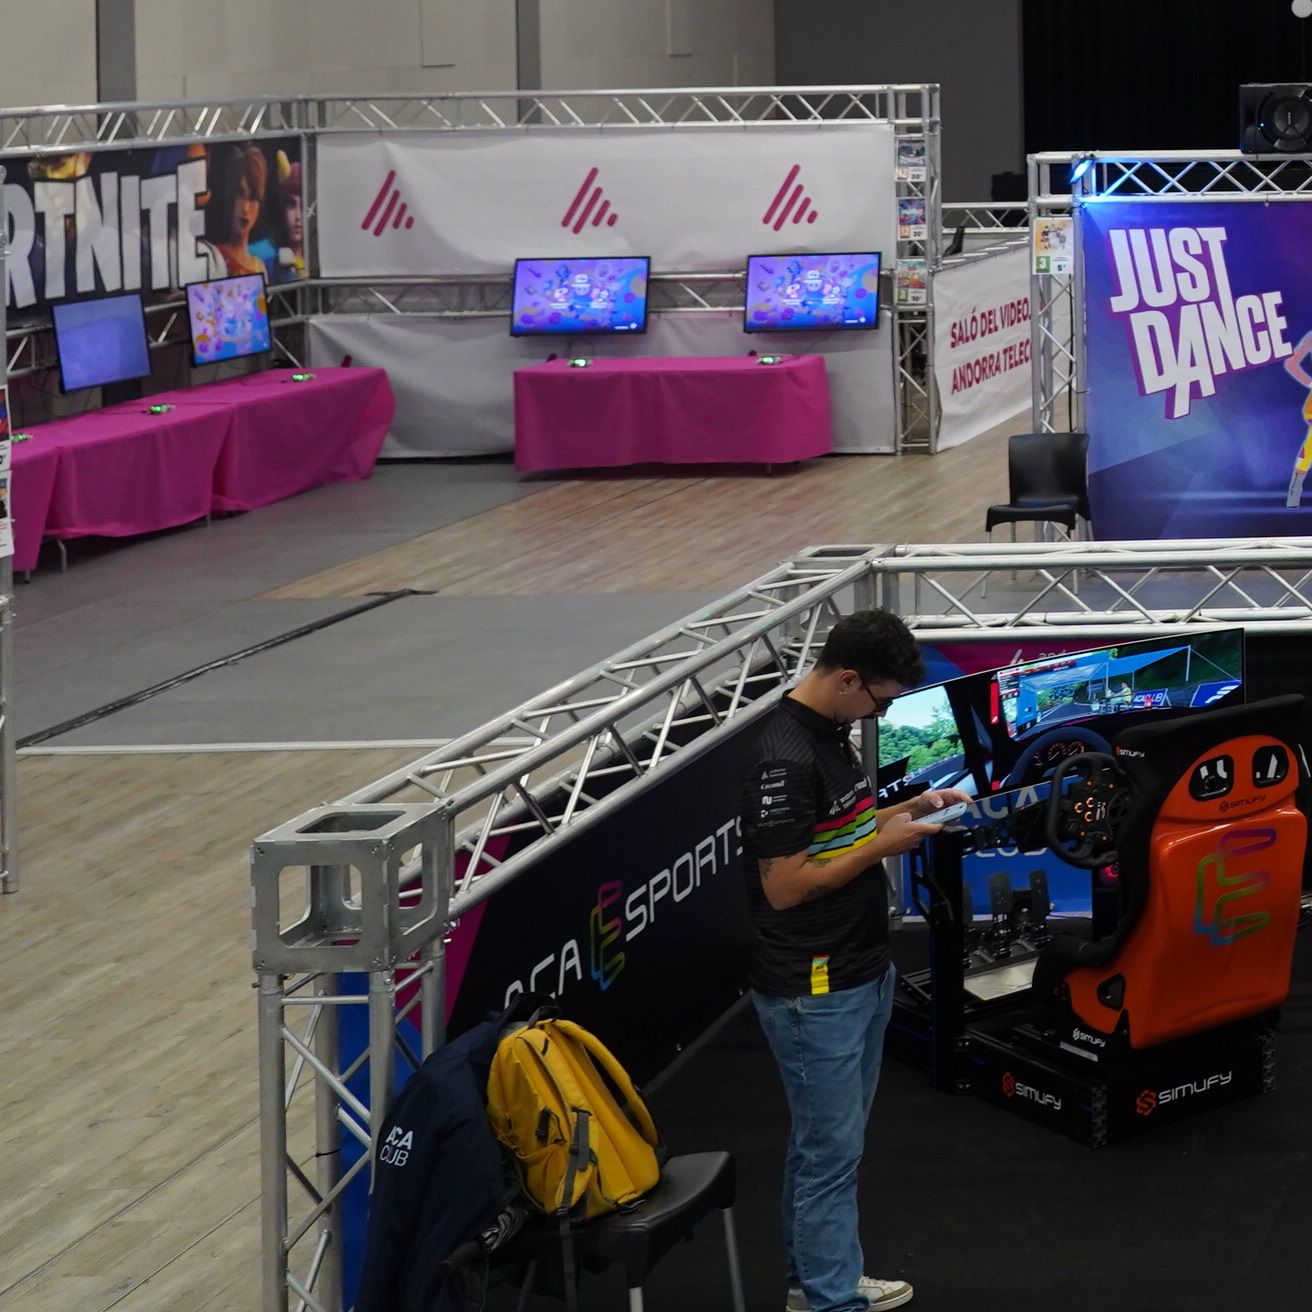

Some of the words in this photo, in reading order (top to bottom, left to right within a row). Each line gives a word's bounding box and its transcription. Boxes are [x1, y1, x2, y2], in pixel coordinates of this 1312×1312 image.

[3, 158, 209, 309] RTNITE
[1109, 226, 1229, 314] JUST
[950, 306, 978, 348] SALÓ
[980, 309, 998, 338] DEL
[1000, 297, 1040, 329] VIDEO
[951, 350, 1002, 395] ANDORRA
[1002, 338, 1033, 372] TELEC
[1129, 291, 1293, 418] DANCE
[1015, 1082, 1062, 1111] SIMUFY
[1159, 1070, 1233, 1105] SIMUFY
